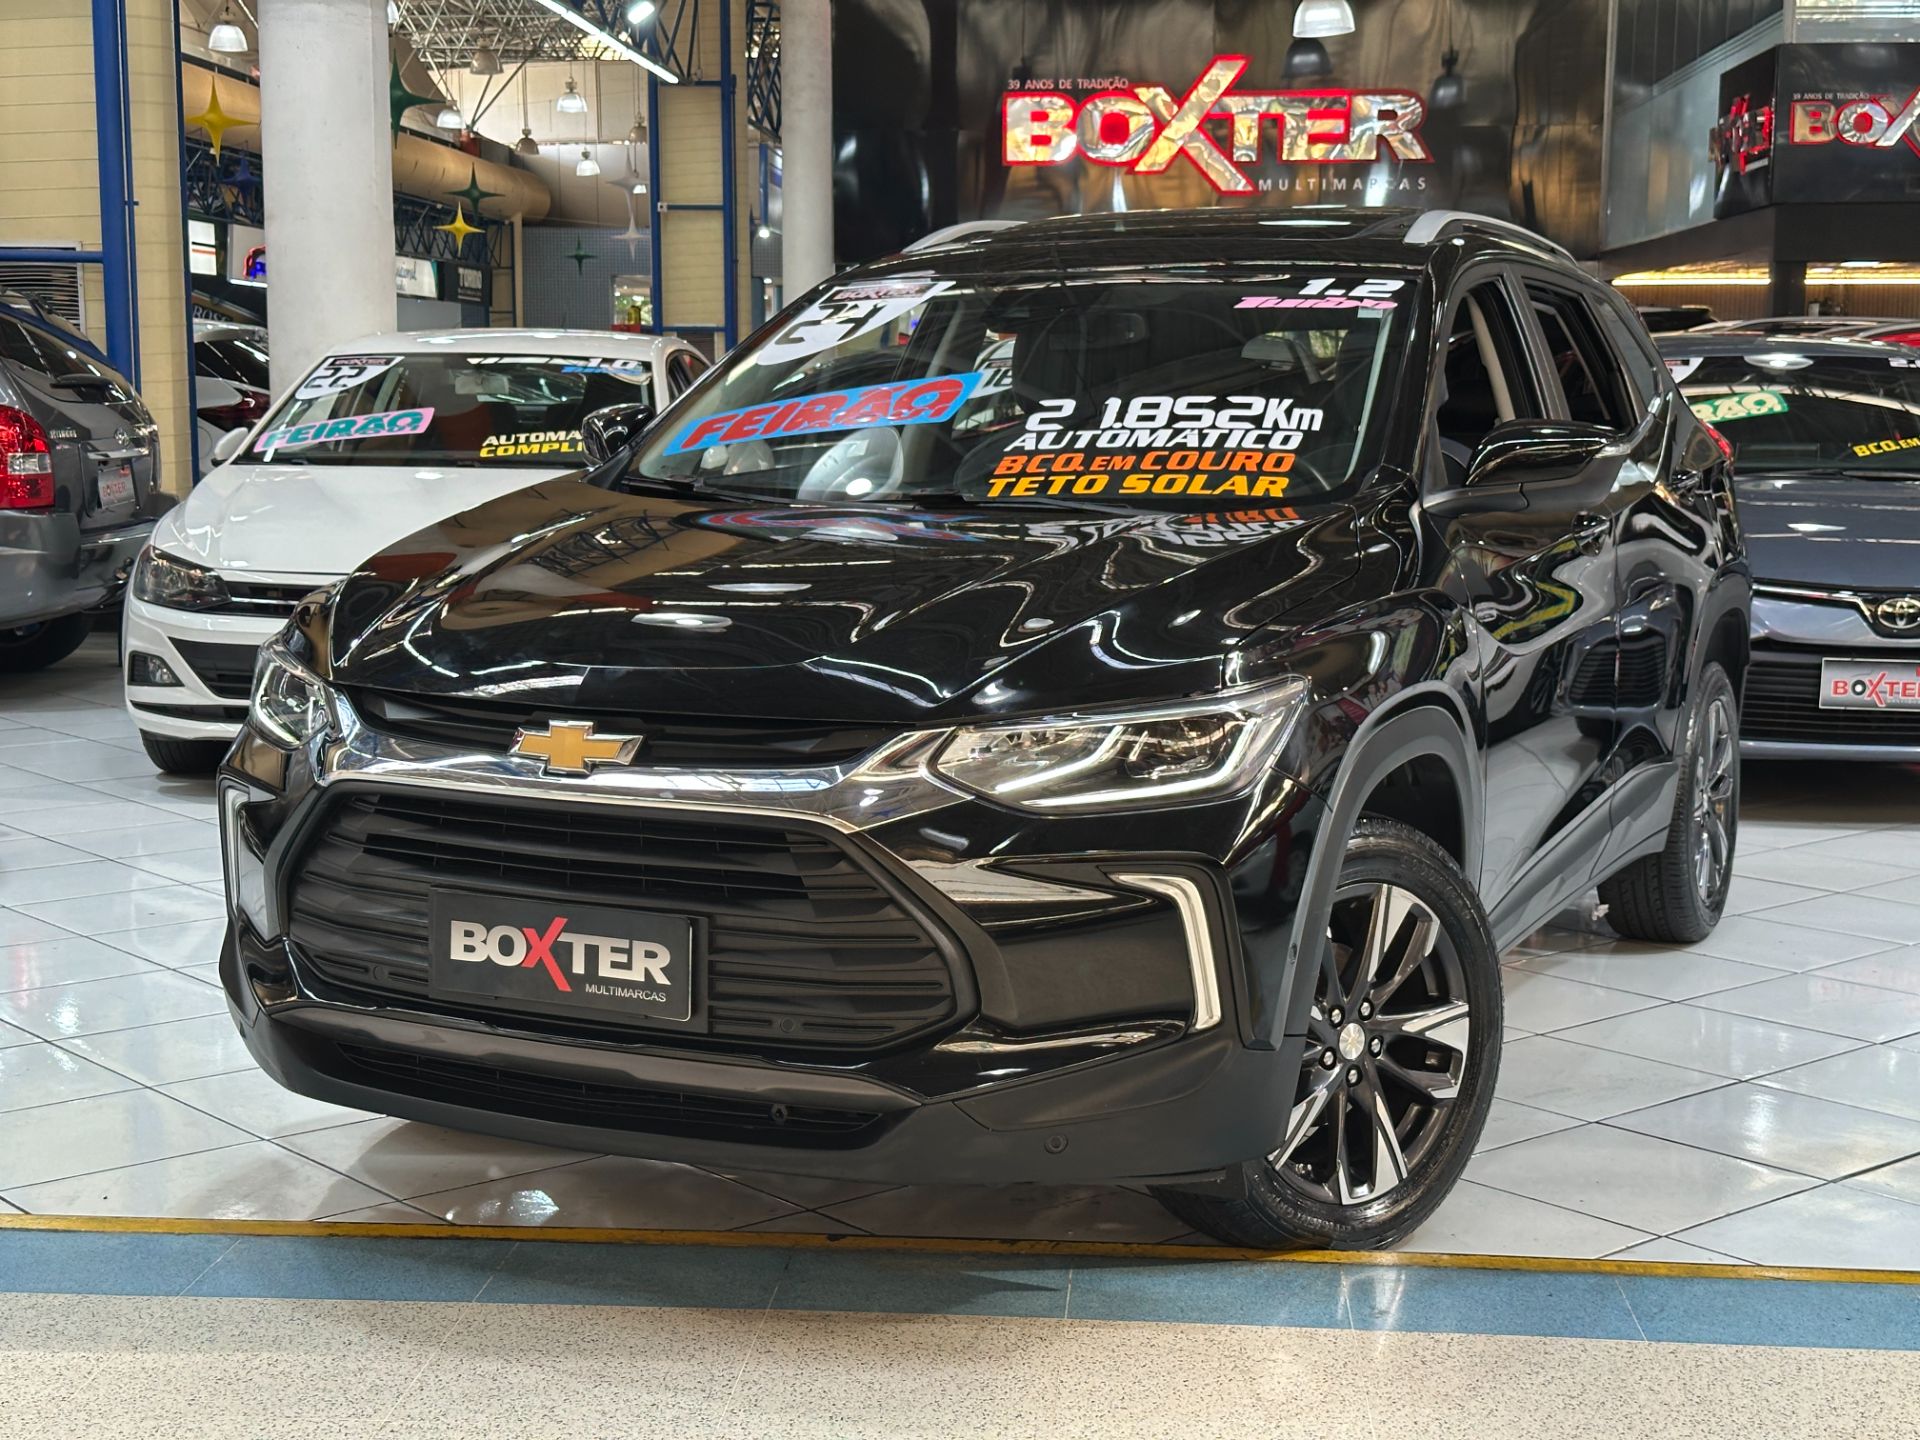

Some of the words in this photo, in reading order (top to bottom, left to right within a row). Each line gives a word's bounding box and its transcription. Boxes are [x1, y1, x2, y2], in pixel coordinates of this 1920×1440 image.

[1008, 79, 1020, 90] 39
[1024, 79, 1054, 90] ANOS
[1059, 79, 1072, 89] DE
[1078, 76, 1129, 91] TRADIÇÃO
[1002, 54, 1435, 196] BOXTER
[1258, 177, 1427, 192] MULTIMARCAS
[1299, 277, 1406, 298] 1.2
[1139, 450, 1296, 473] COURO
[986, 474, 1110, 497] TETO
[1118, 474, 1290, 498] SOLAR
[451, 916, 672, 992] BOXTER
[585, 983, 667, 1003] MULTIMARCAS
